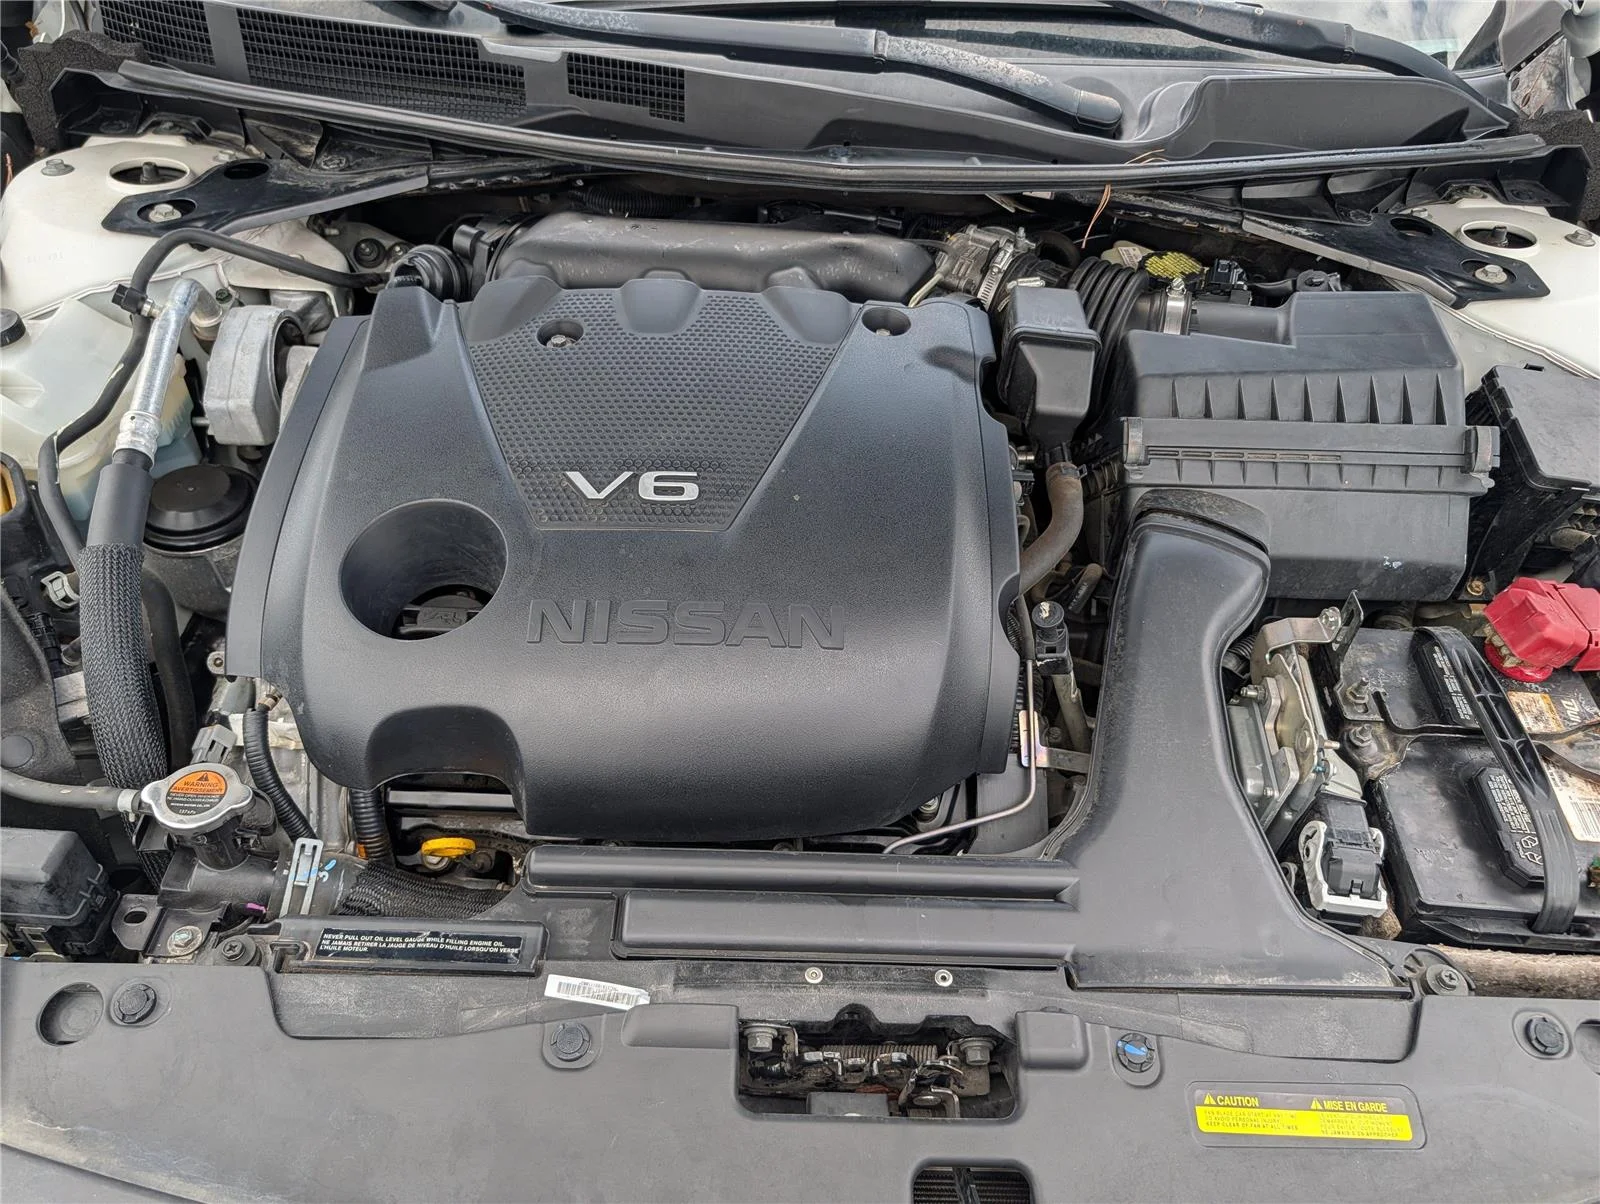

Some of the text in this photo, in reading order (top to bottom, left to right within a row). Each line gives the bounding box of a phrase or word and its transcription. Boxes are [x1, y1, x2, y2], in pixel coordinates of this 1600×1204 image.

[565, 471, 699, 501] V6
[527, 600, 844, 650] NISSAN
[439, 943, 463, 951] D'HUILE
[1216, 1095, 1260, 1107] CAUTION
[1323, 1100, 1388, 1112] MISE EN GARDE
